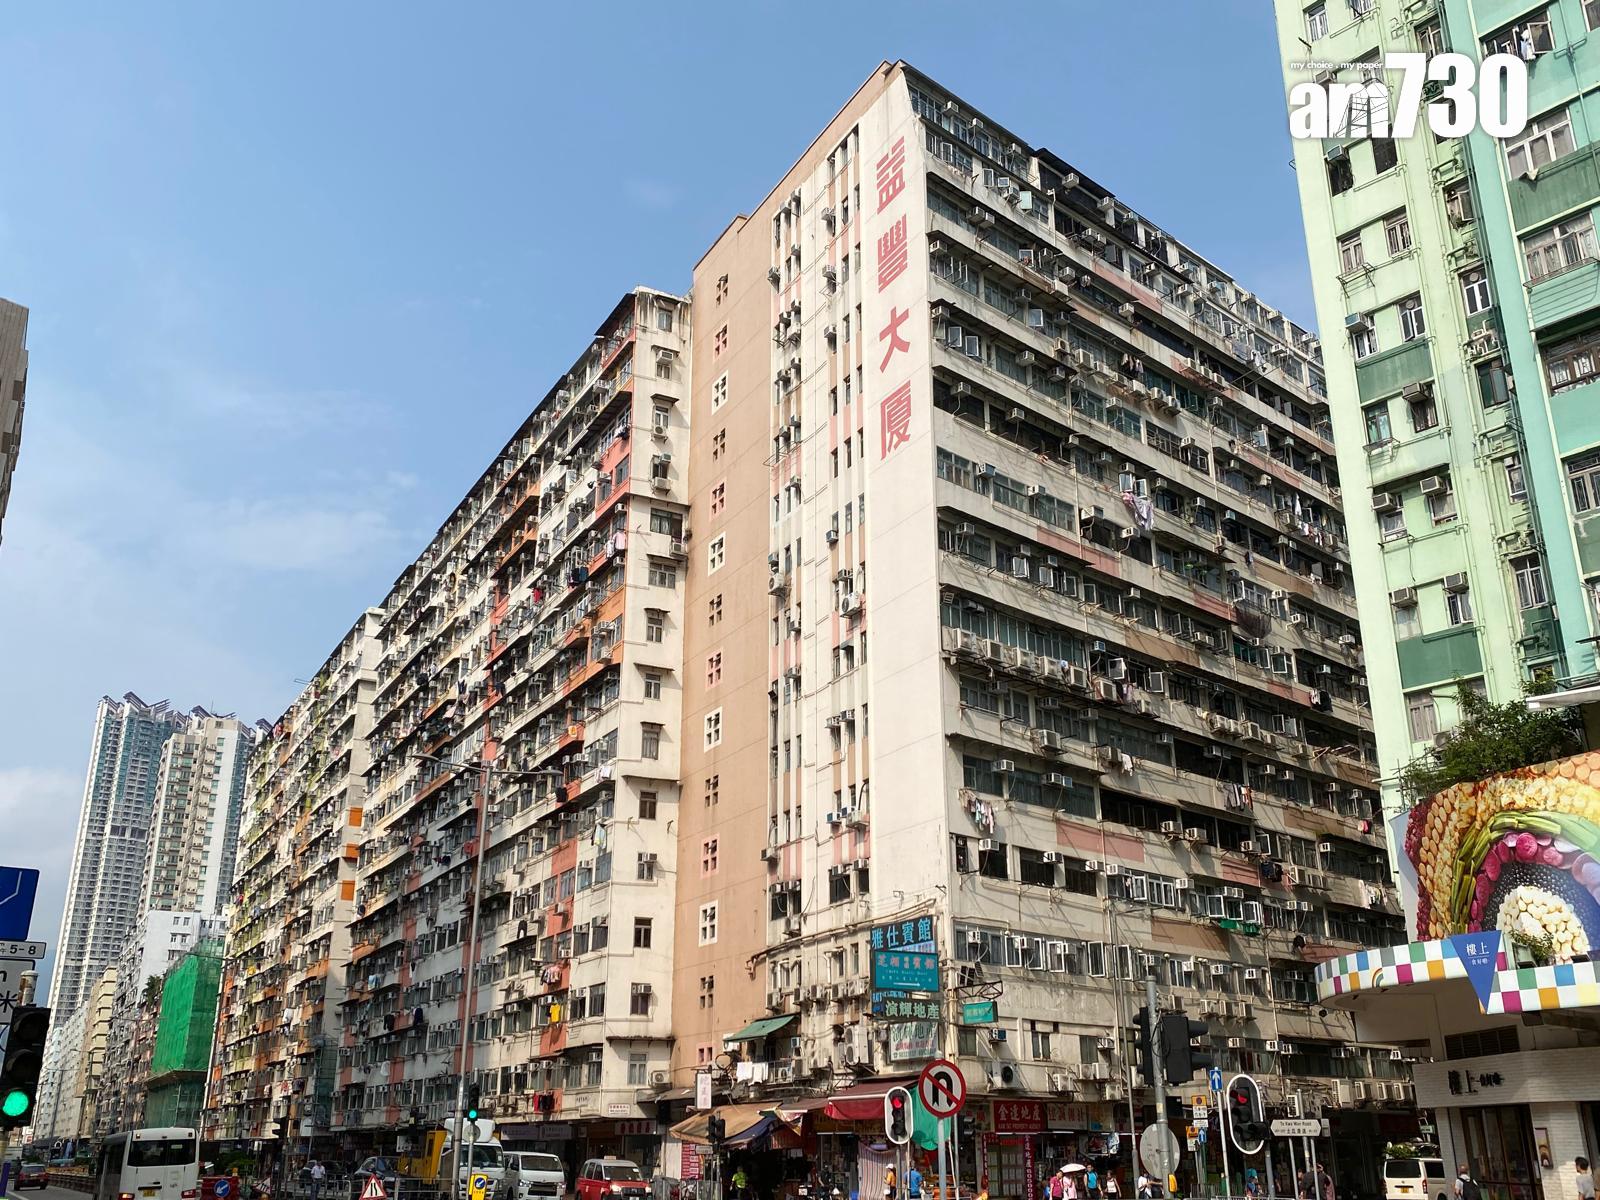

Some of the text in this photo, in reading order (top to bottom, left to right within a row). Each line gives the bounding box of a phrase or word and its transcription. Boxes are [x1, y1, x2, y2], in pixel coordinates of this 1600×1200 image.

[872, 917, 931, 950] 雅仕賓館
[1466, 942, 1489, 956] 樓上
[885, 1000, 940, 1019] 演輝地產
